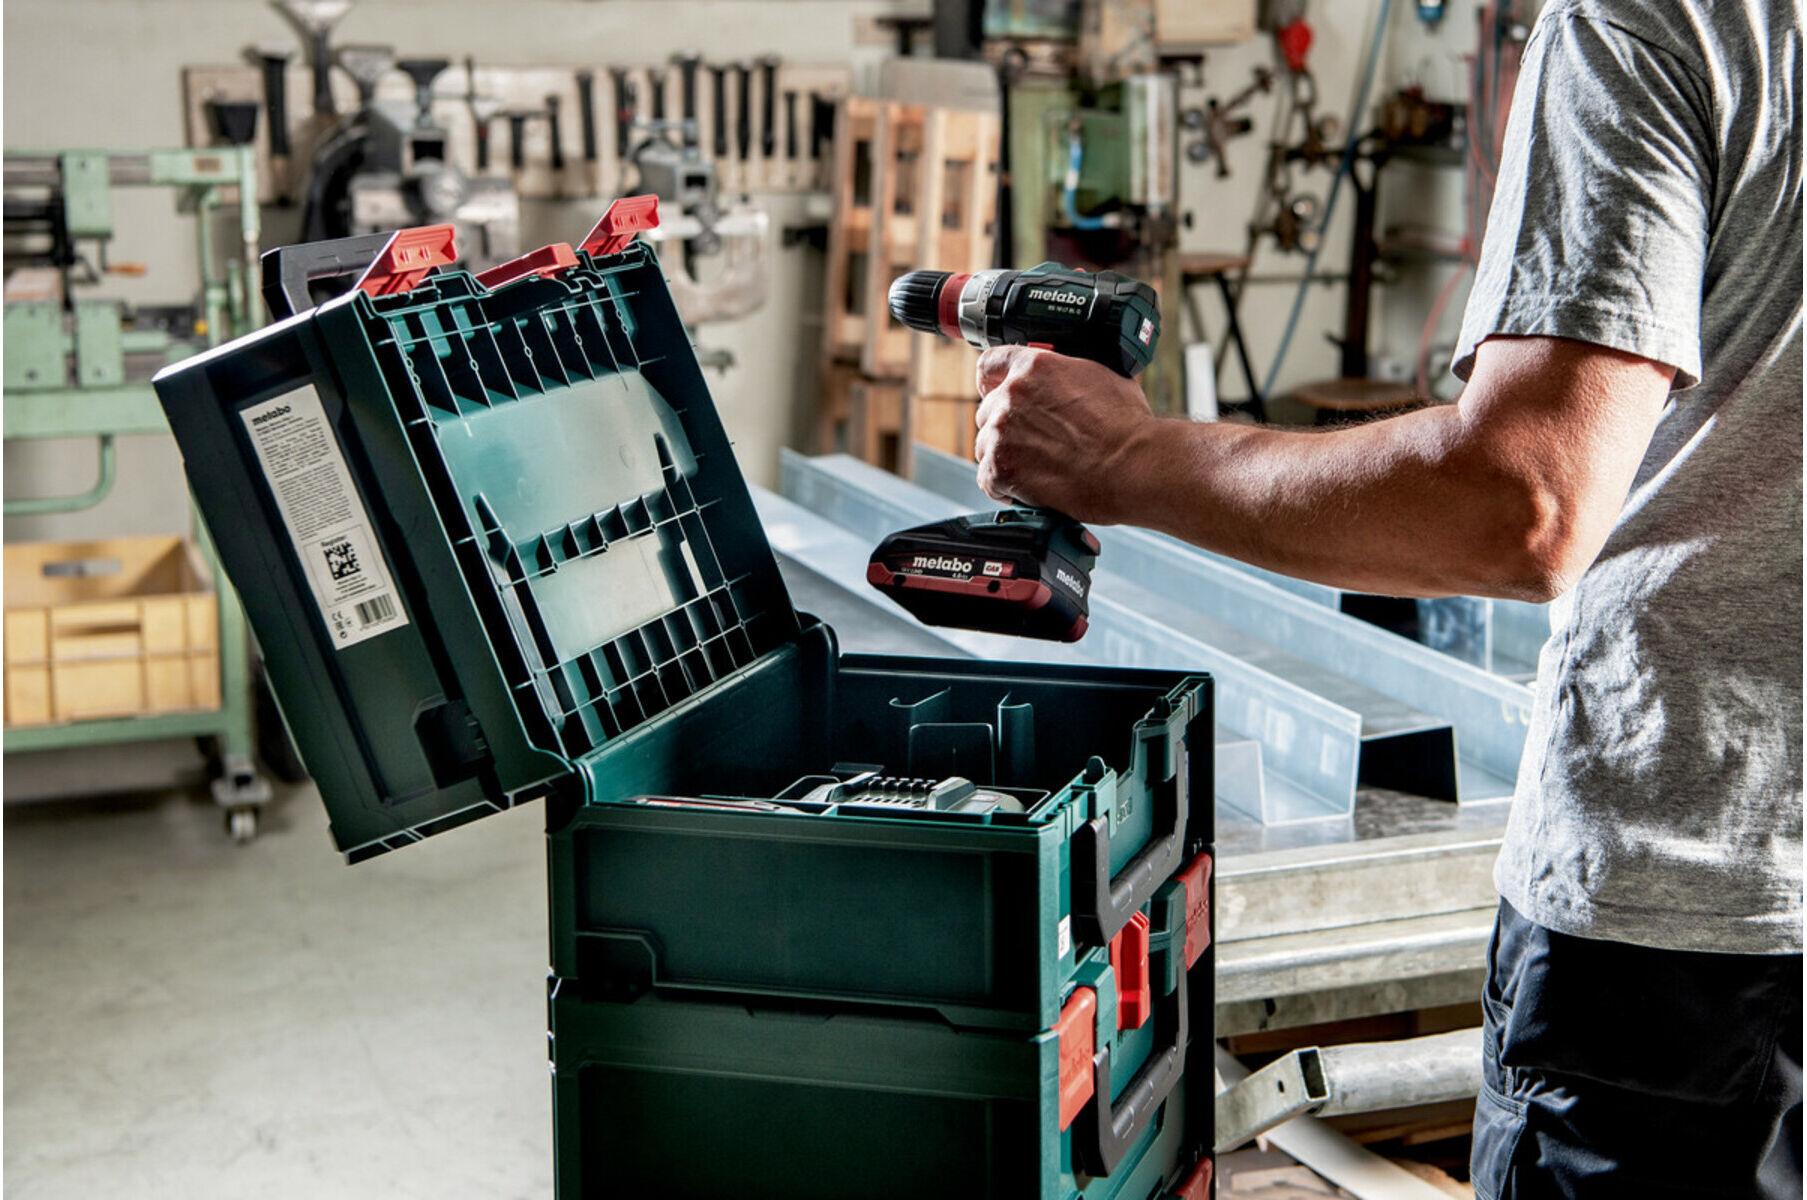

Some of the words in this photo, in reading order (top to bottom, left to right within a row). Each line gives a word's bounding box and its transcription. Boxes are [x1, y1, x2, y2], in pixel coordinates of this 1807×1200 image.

[1028, 289, 1086, 306] metabo
[252, 403, 292, 426] metabo
[912, 555, 973, 573] metabo
[1056, 568, 1085, 598] metabo
